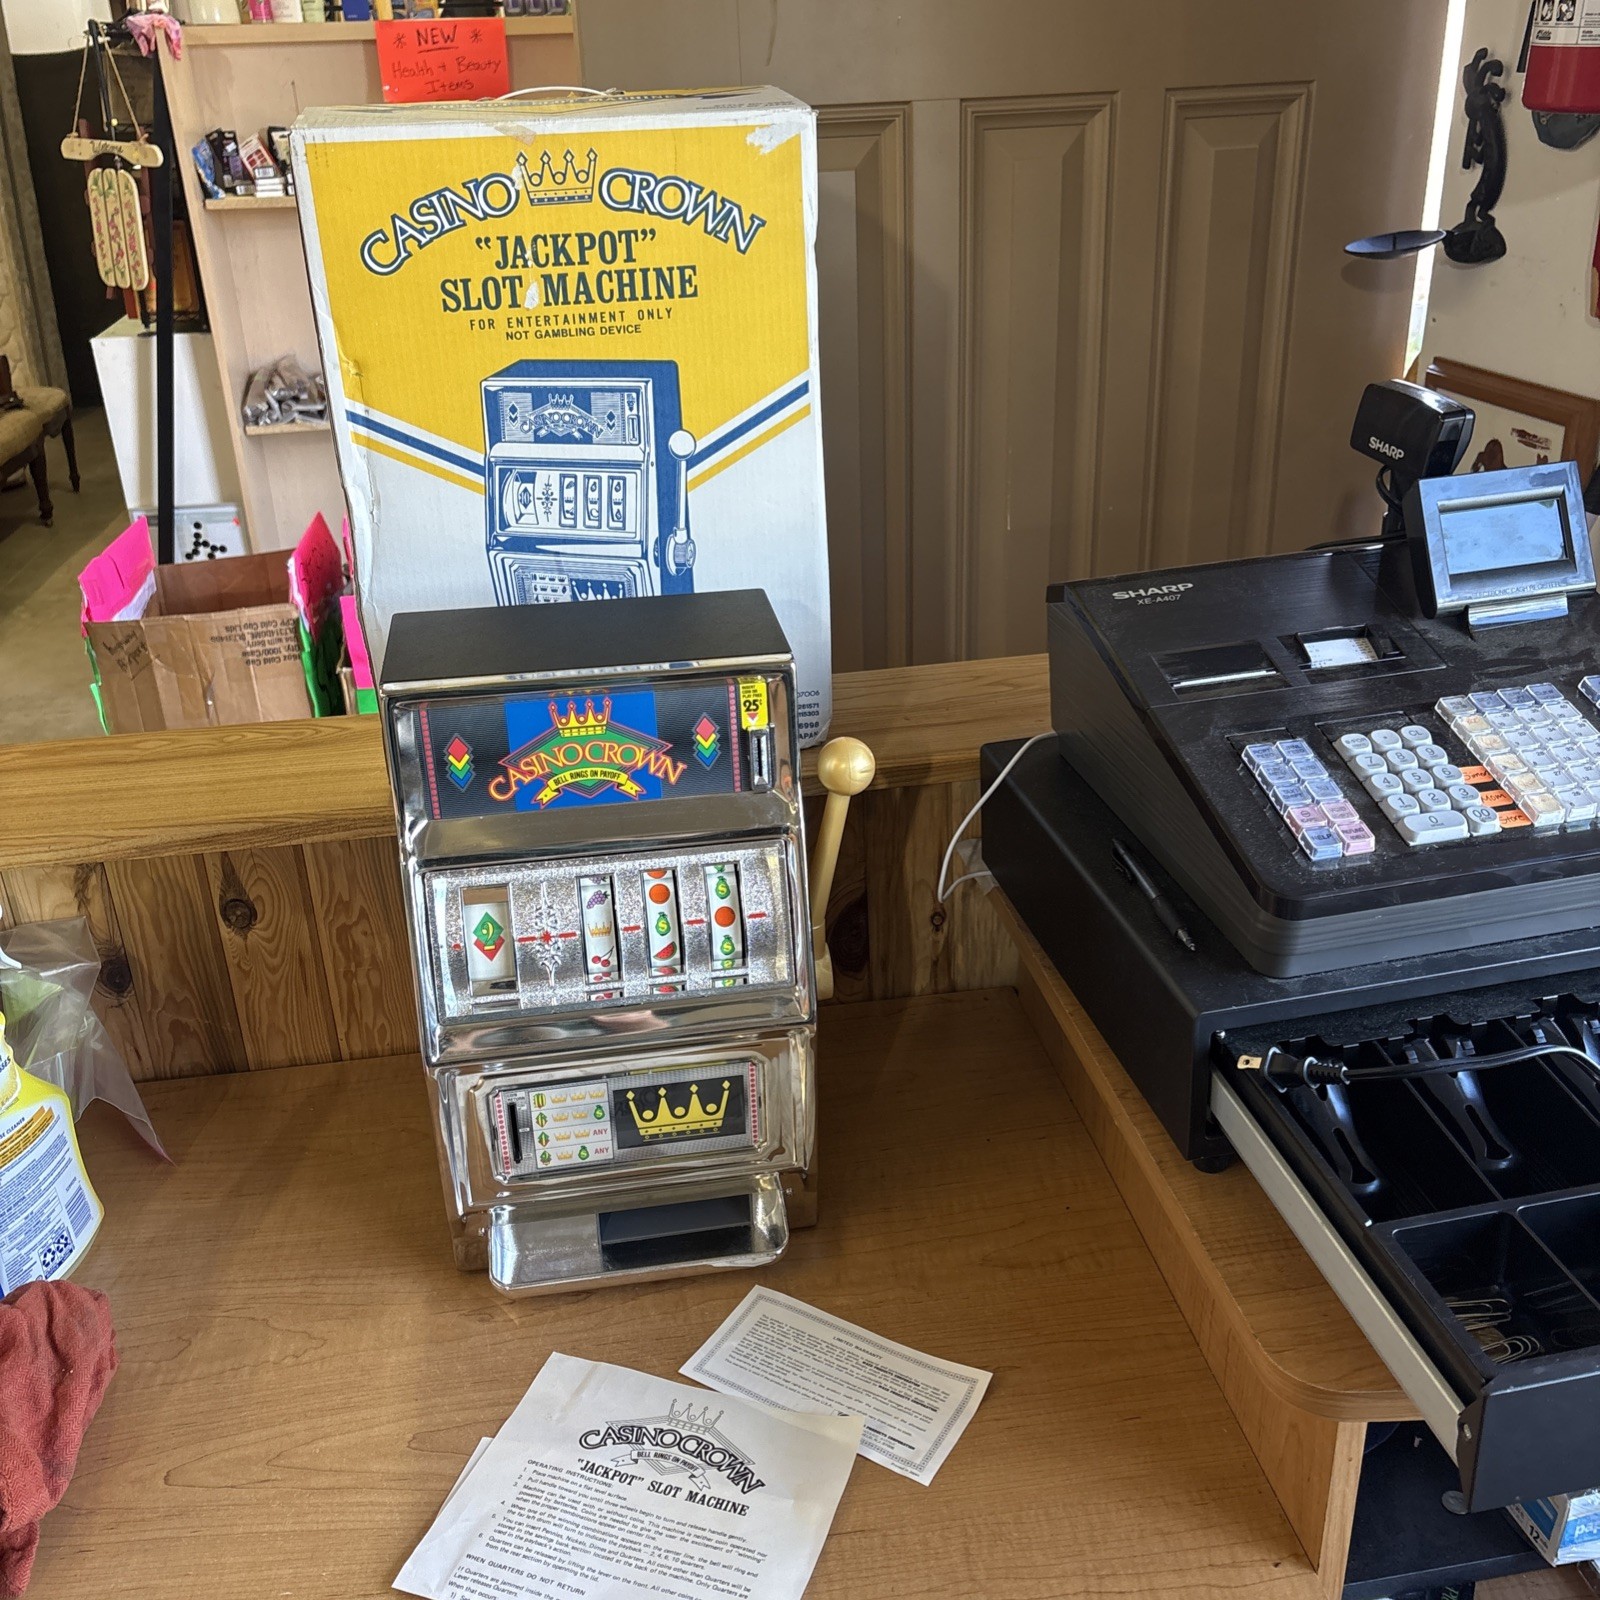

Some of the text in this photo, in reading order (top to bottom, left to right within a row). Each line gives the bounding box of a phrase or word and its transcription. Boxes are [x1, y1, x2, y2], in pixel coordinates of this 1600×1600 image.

[416, 25, 457, 46] NEW
[392, 60, 434, 78] Health
[456, 56, 501, 74] Beauty
[424, 79, 475, 95] Items
[360, 167, 767, 276] CASINO CROWN
[475, 228, 657, 271] “JACKPOT”
[440, 264, 699, 313] SLOT MACHINE
[469, 306, 673, 331] FOR ENTERTAINMENT ONLY
[506, 323, 642, 342] NOT GAMBLING DEVICE
[1368, 436, 1405, 460] SHARP
[1112, 583, 1194, 600] SHARP
[1137, 594, 1182, 606] XE-A407
[798, 731, 819, 740] APAN
[1366, 748, 1434, 764] 7 8 9
[488, 741, 687, 801] CASINOCROWN
[553, 775, 569, 787] BELL
[569, 770, 588, 780] RINGS
[600, 770, 621, 780] PAYOFF
[1412, 772, 1420, 781] 5
[1442, 767, 1451, 775] 6
[1398, 788, 1469, 806] 1 2 3
[1428, 809, 1490, 824] 0 00
[1499, 814, 1525, 824] Store
[592, 1128, 608, 1137] ANY
[594, 1147, 610, 1155] ANY
[579, 1425, 765, 1494] CASINOCROWN
[653, 1452, 671, 1461] RINGS
[671, 1456, 679, 1464] ON
[679, 1459, 699, 1473] PAYOFF
[527, 1459, 612, 1488] OPERATING INSTRUCTIONS:
[532, 1469, 546, 1477] Place
[547, 1474, 570, 1483] machine
[577, 1458, 750, 1517] “JACKPOT” SLOT MACHINE
[523, 1484, 545, 1494] Machine
[606, 1510, 628, 1519] without
[648, 1521, 660, 1529] This
[661, 1526, 685, 1535] machine
[693, 1534, 713, 1542] neither
[729, 1543, 756, 1554] operated
[539, 1480, 557, 1488] handle
[558, 1485, 578, 1495] toward
[619, 1505, 638, 1513] wheels
[639, 1509, 654, 1517] begin
[687, 1524, 707, 1532] release
[708, 1528, 727, 1537] handle
[540, 1503, 560, 1511] proper
[560, 1508, 598, 1524] combinations
[598, 1521, 617, 1529] appear
[518, 1491, 543, 1500] powered
[581, 1508, 597, 1517] Coins
[609, 1517, 630, 1526] needed
[691, 1540, 724, 1552] excitement
[1529, 1525, 1540, 1543] 12
[466, 1554, 586, 1596] WHEN QUARTERS DO NOT RETURN
